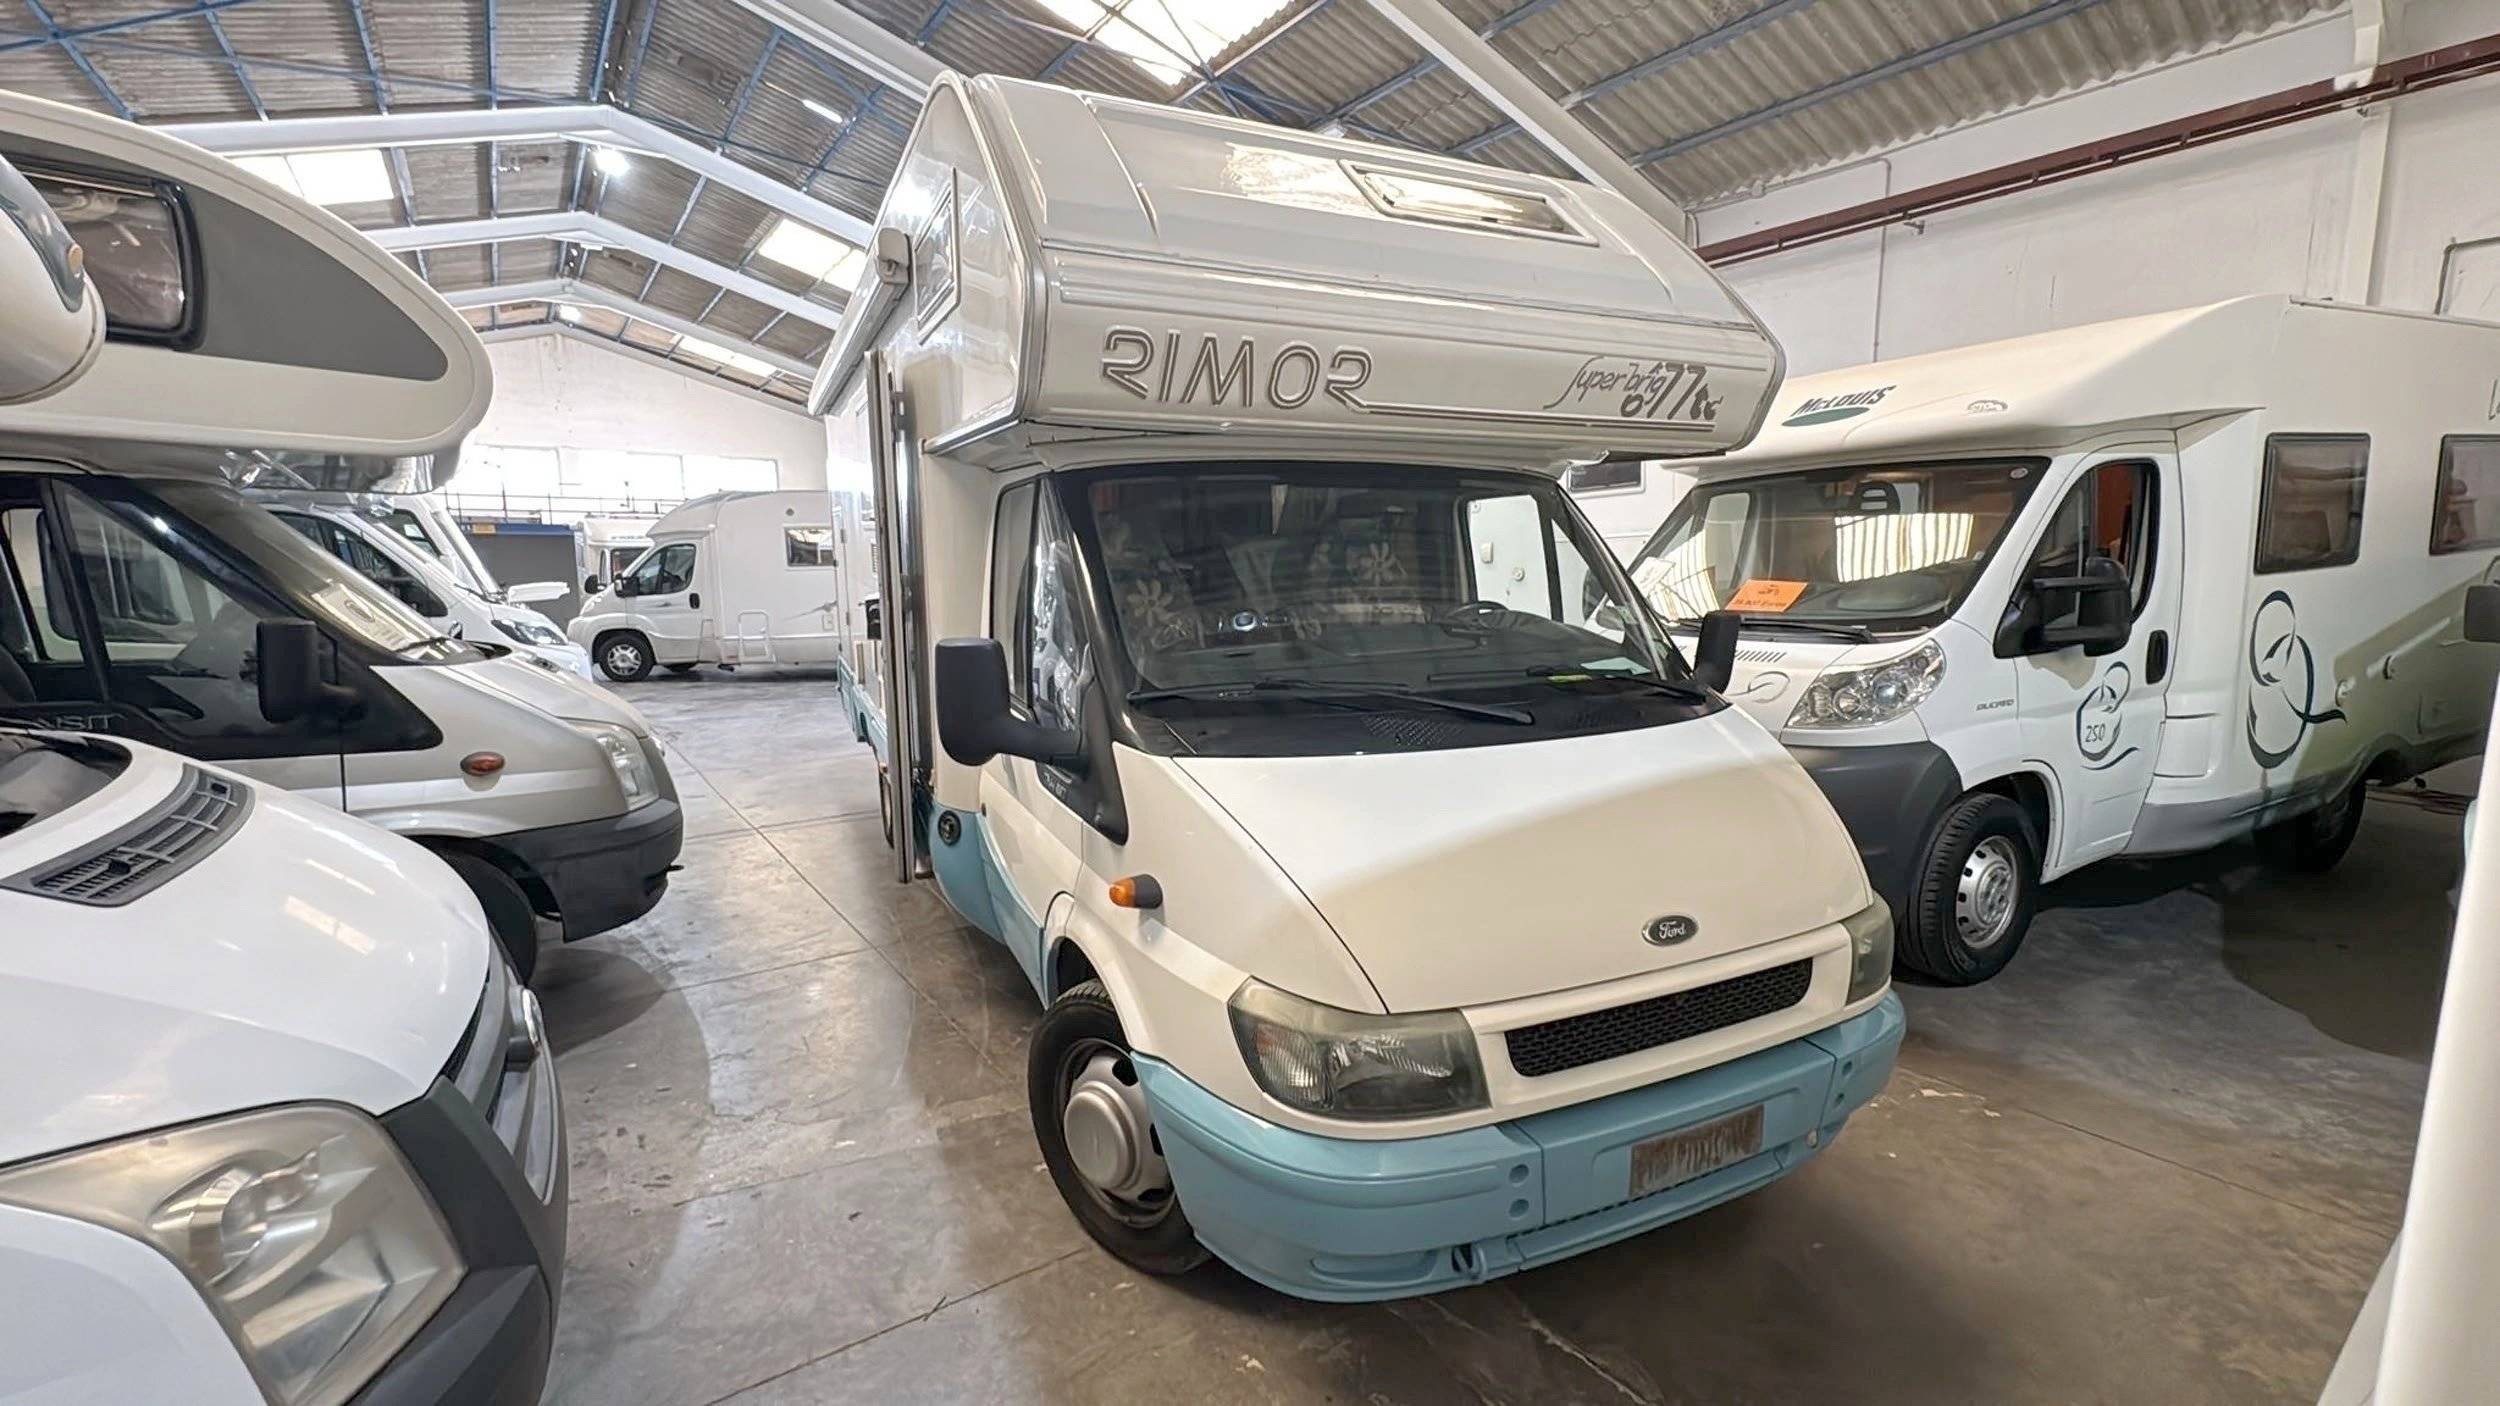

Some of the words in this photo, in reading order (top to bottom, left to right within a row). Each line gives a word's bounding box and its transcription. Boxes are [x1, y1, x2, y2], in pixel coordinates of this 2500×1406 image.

[1101, 325, 1373, 413] RIMOR
[2085, 723, 2106, 743] 250
[1659, 920, 1687, 939] Ford
